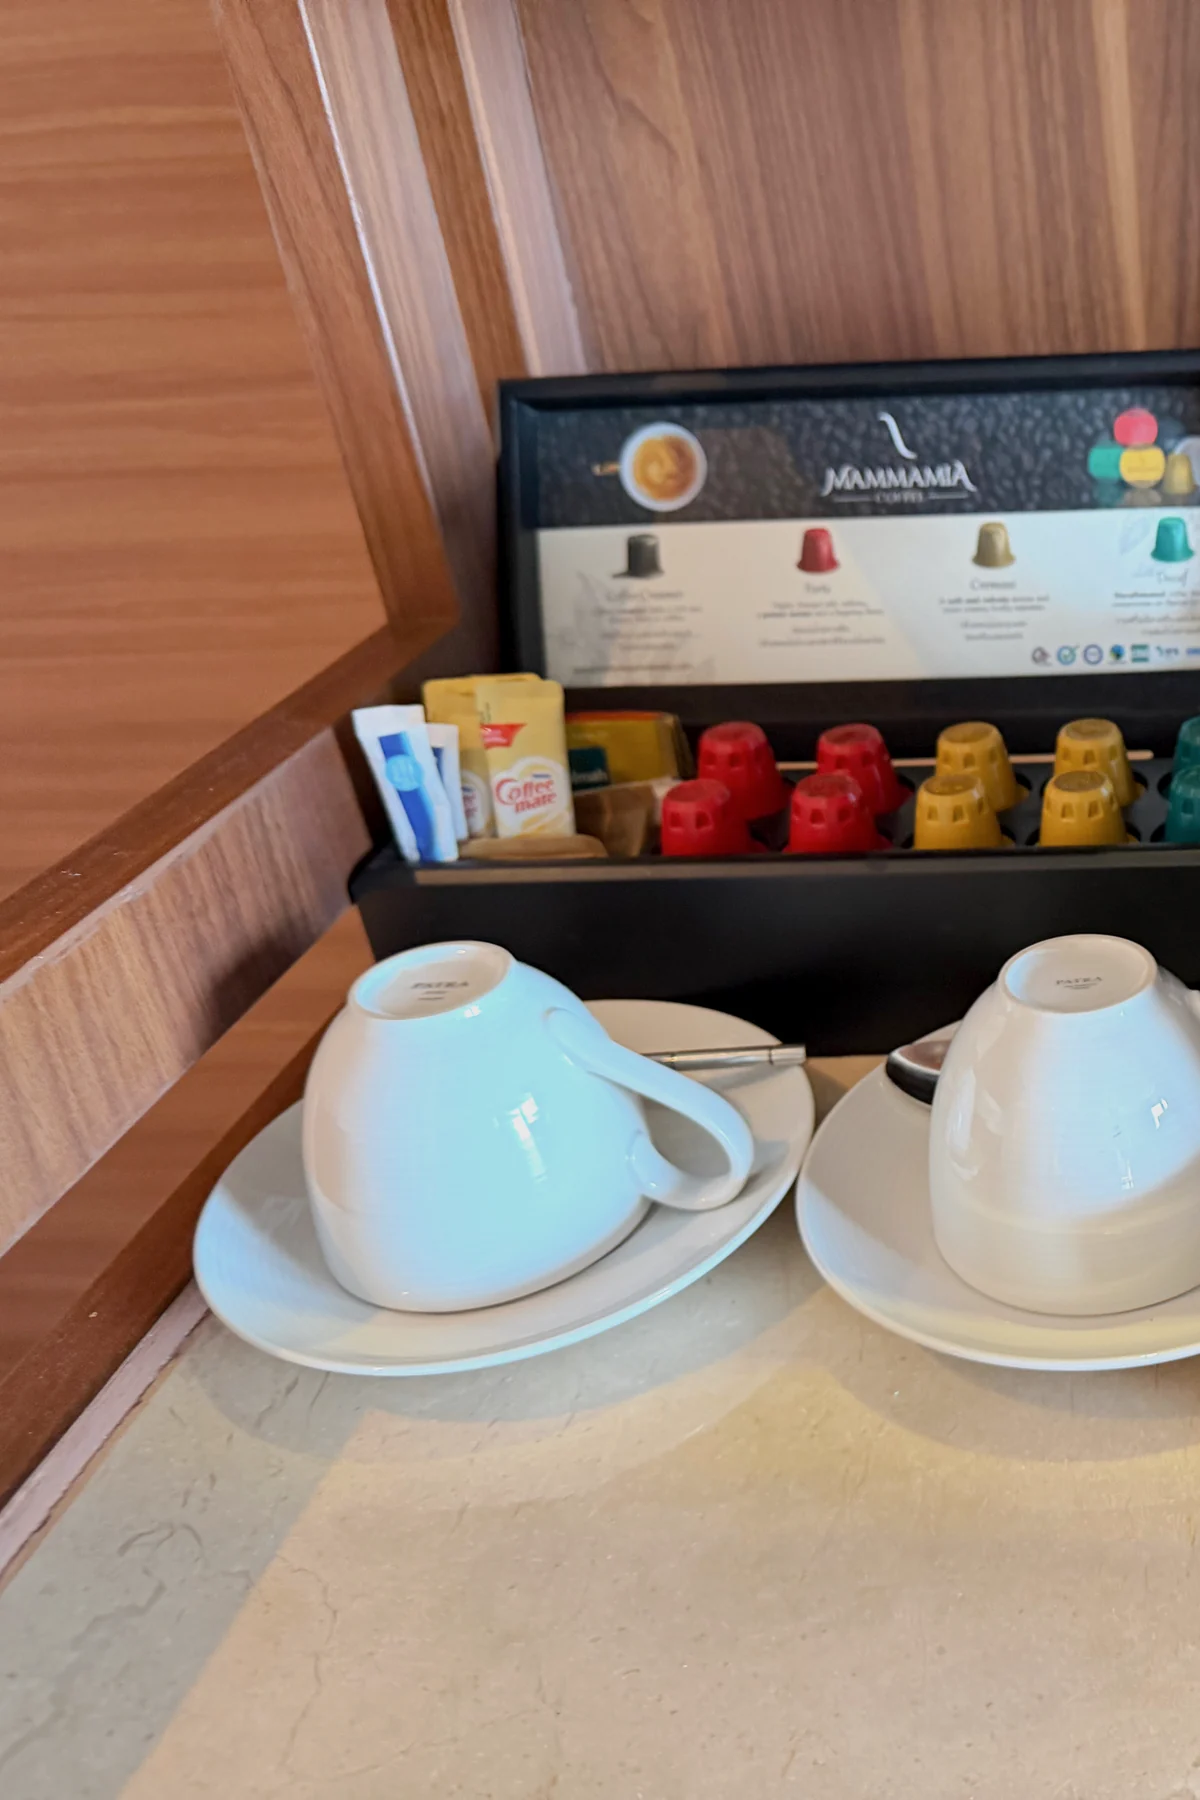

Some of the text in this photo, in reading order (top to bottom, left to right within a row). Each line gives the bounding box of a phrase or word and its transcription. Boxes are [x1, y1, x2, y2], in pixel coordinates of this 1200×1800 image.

[820, 459, 978, 497] MAMMAMIA
[495, 778, 554, 805] Coffee
[515, 793, 557, 814] mate
